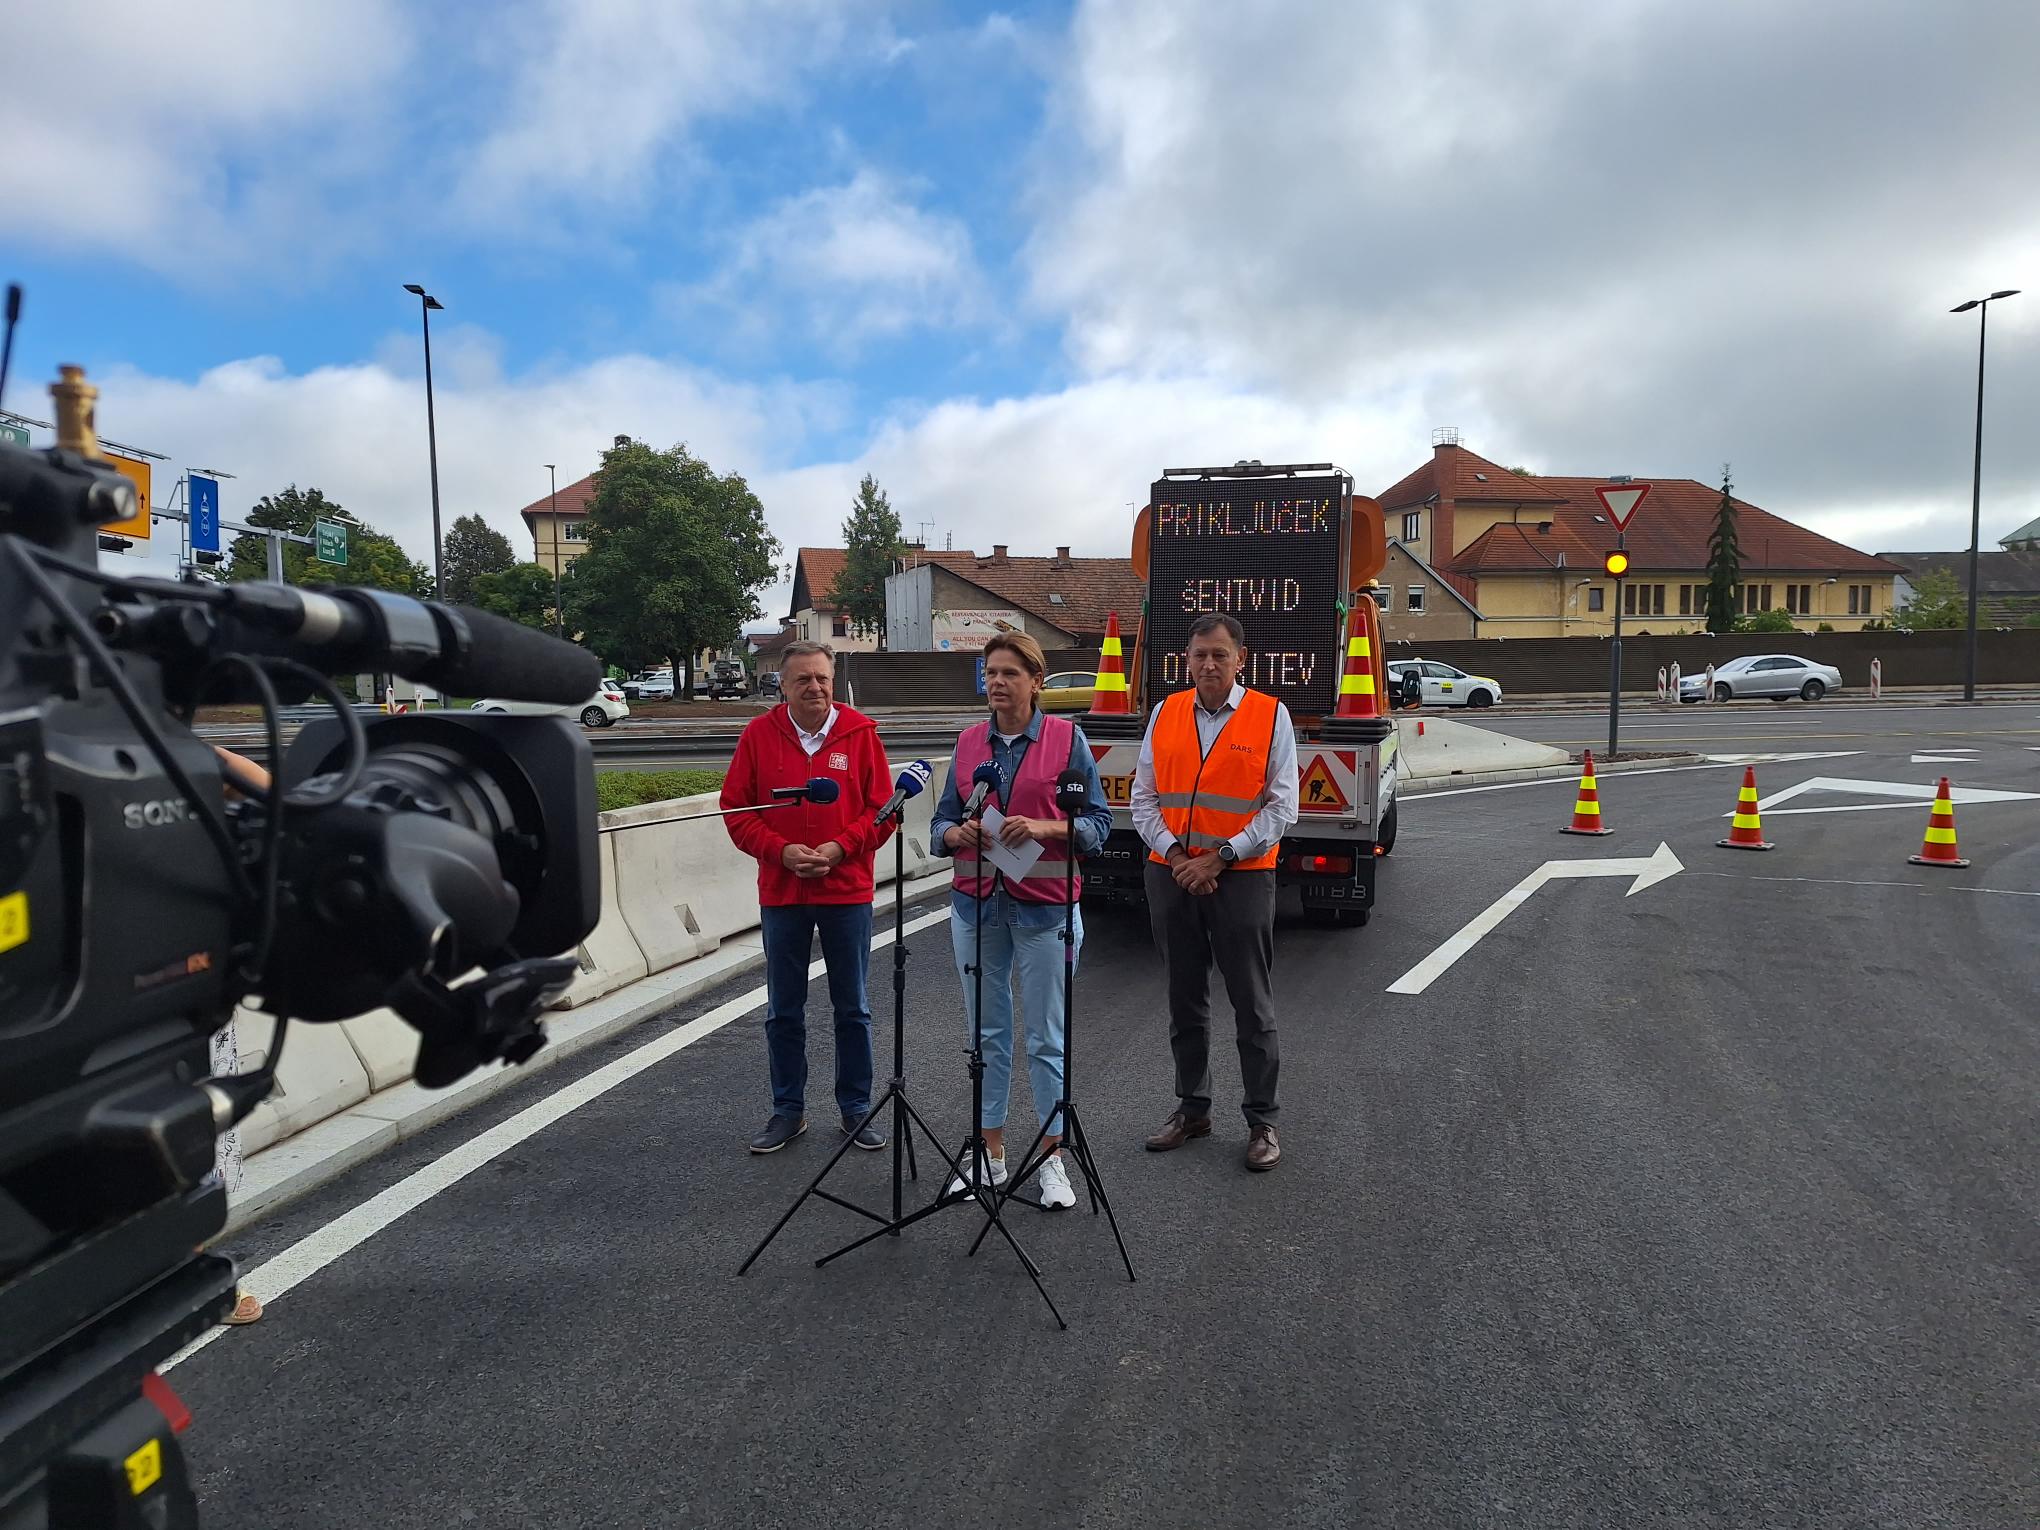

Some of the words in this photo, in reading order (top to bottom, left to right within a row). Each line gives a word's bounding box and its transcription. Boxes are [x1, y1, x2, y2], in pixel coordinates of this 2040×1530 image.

[1159, 499, 1329, 536] PRIKLJUČEK
[1182, 578, 1300, 612] ŠENTVID
[1231, 744, 1251, 753] DARS
[124, 798, 199, 829] SON
